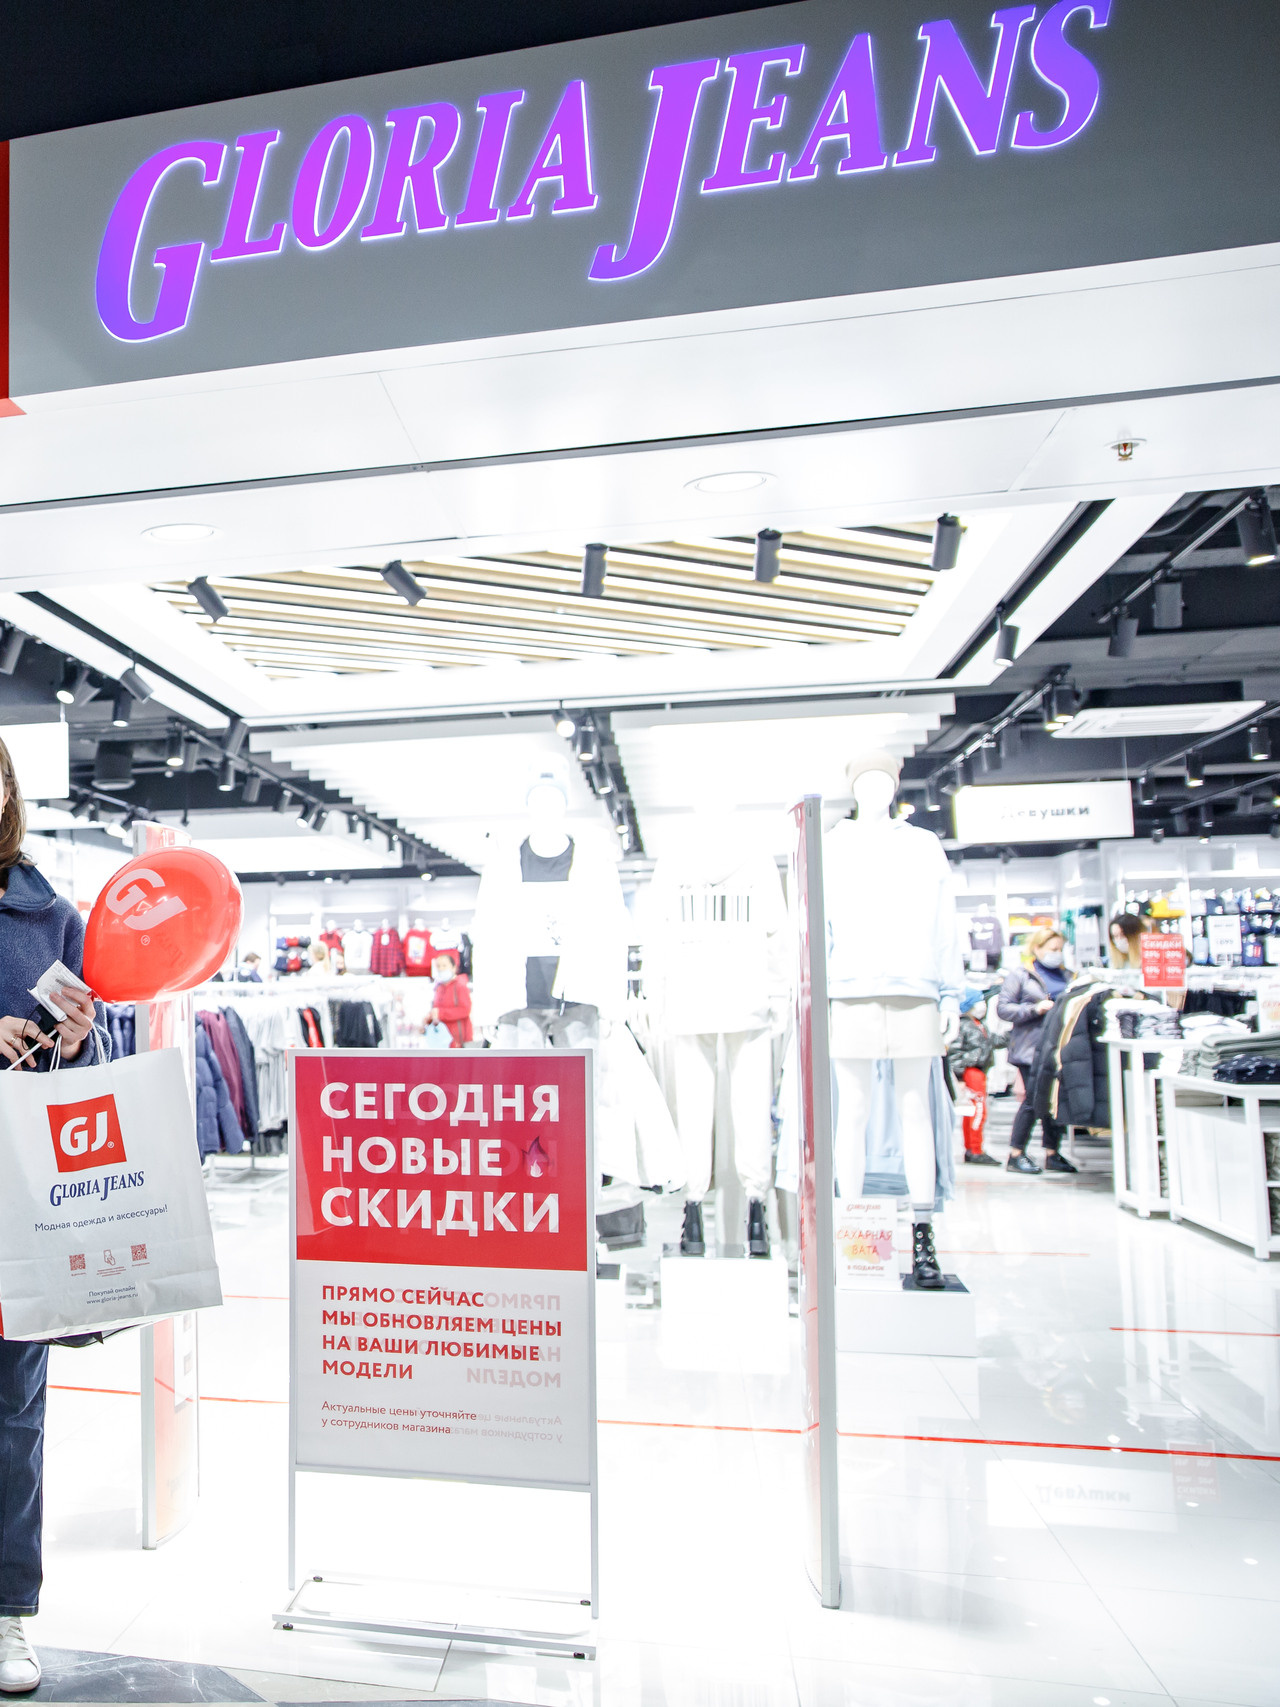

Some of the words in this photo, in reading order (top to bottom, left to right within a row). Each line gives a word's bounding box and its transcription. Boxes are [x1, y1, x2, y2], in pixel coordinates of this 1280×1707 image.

[94, 79, 598, 342] GLORIA
[587, 0, 1114, 283] JEANS
[105, 868, 188, 931] GJ
[319, 1082, 560, 1127] СЕГОДНЯ
[60, 1110, 108, 1157] GJ
[322, 1137, 503, 1176] НОВЫЕ
[50, 1179, 101, 1207] GLORIA
[100, 1171, 145, 1201] JEANS
[35, 1222, 71, 1232] Модная
[72, 1215, 107, 1229] одежда
[116, 1204, 168, 1222] аксессуары!
[320, 1188, 560, 1237] СКИДКИ
[837, 1230, 893, 1240] САХАРНАЯ
[852, 1245, 880, 1256] ВАТА
[86, 1293, 139, 1304] www.gloria-jeans.ru
[89, 1288, 114, 1297] Покупай
[114, 1286, 136, 1294] онлайн
[322, 1286, 396, 1303] ПРЯМО
[401, 1286, 485, 1307] СЕЙЧАС
[322, 1311, 356, 1327] МЫ
[365, 1312, 494, 1335] ОБНОВЛЯЕМ
[501, 1317, 562, 1337] ЦЕНЫ
[322, 1336, 351, 1352] НА
[358, 1337, 419, 1356] ВАШИ
[425, 1340, 540, 1362] ЛЮБИМЫЕ
[322, 1360, 413, 1382] МОДЕЛИ
[321, 1401, 387, 1417] Актуальные
[389, 1407, 418, 1418] цены
[420, 1408, 477, 1422] уточняйте
[321, 1420, 327, 1429] у
[330, 1420, 399, 1434] сотрудников
[402, 1424, 451, 1435] магазина
